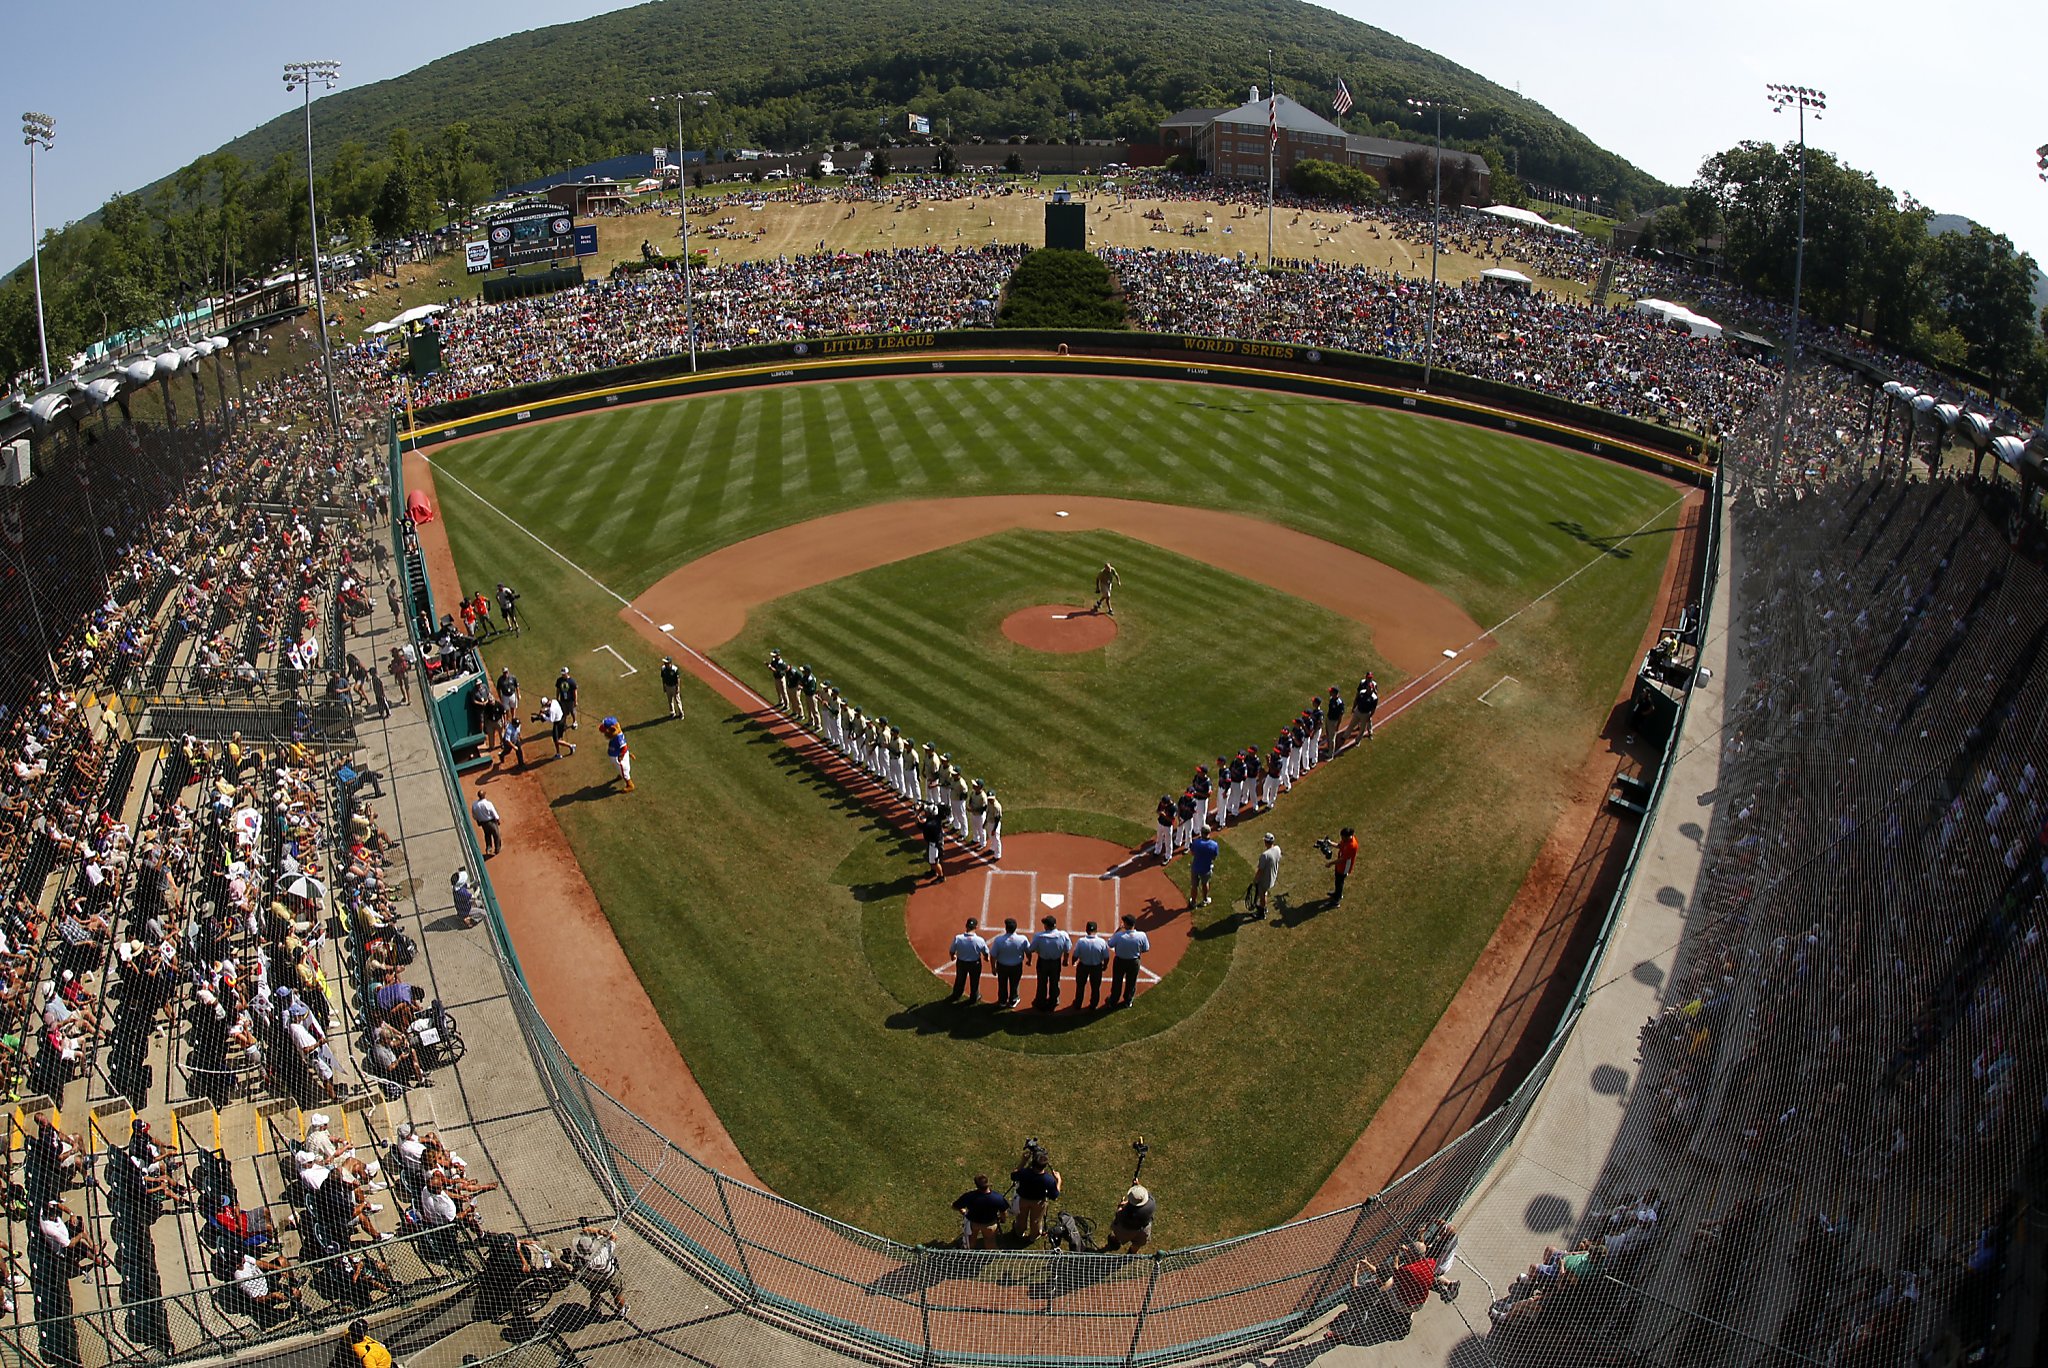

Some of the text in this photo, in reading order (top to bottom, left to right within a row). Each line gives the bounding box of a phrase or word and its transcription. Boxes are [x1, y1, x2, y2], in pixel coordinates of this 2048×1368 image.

[497, 209, 511, 220] LITTLE
[512, 204, 530, 213] LEAGUE
[549, 203, 564, 211] SERIES
[823, 334, 935, 352] LITTLE LEAGUE
[1184, 338, 1294, 359] WORLD SERIES
